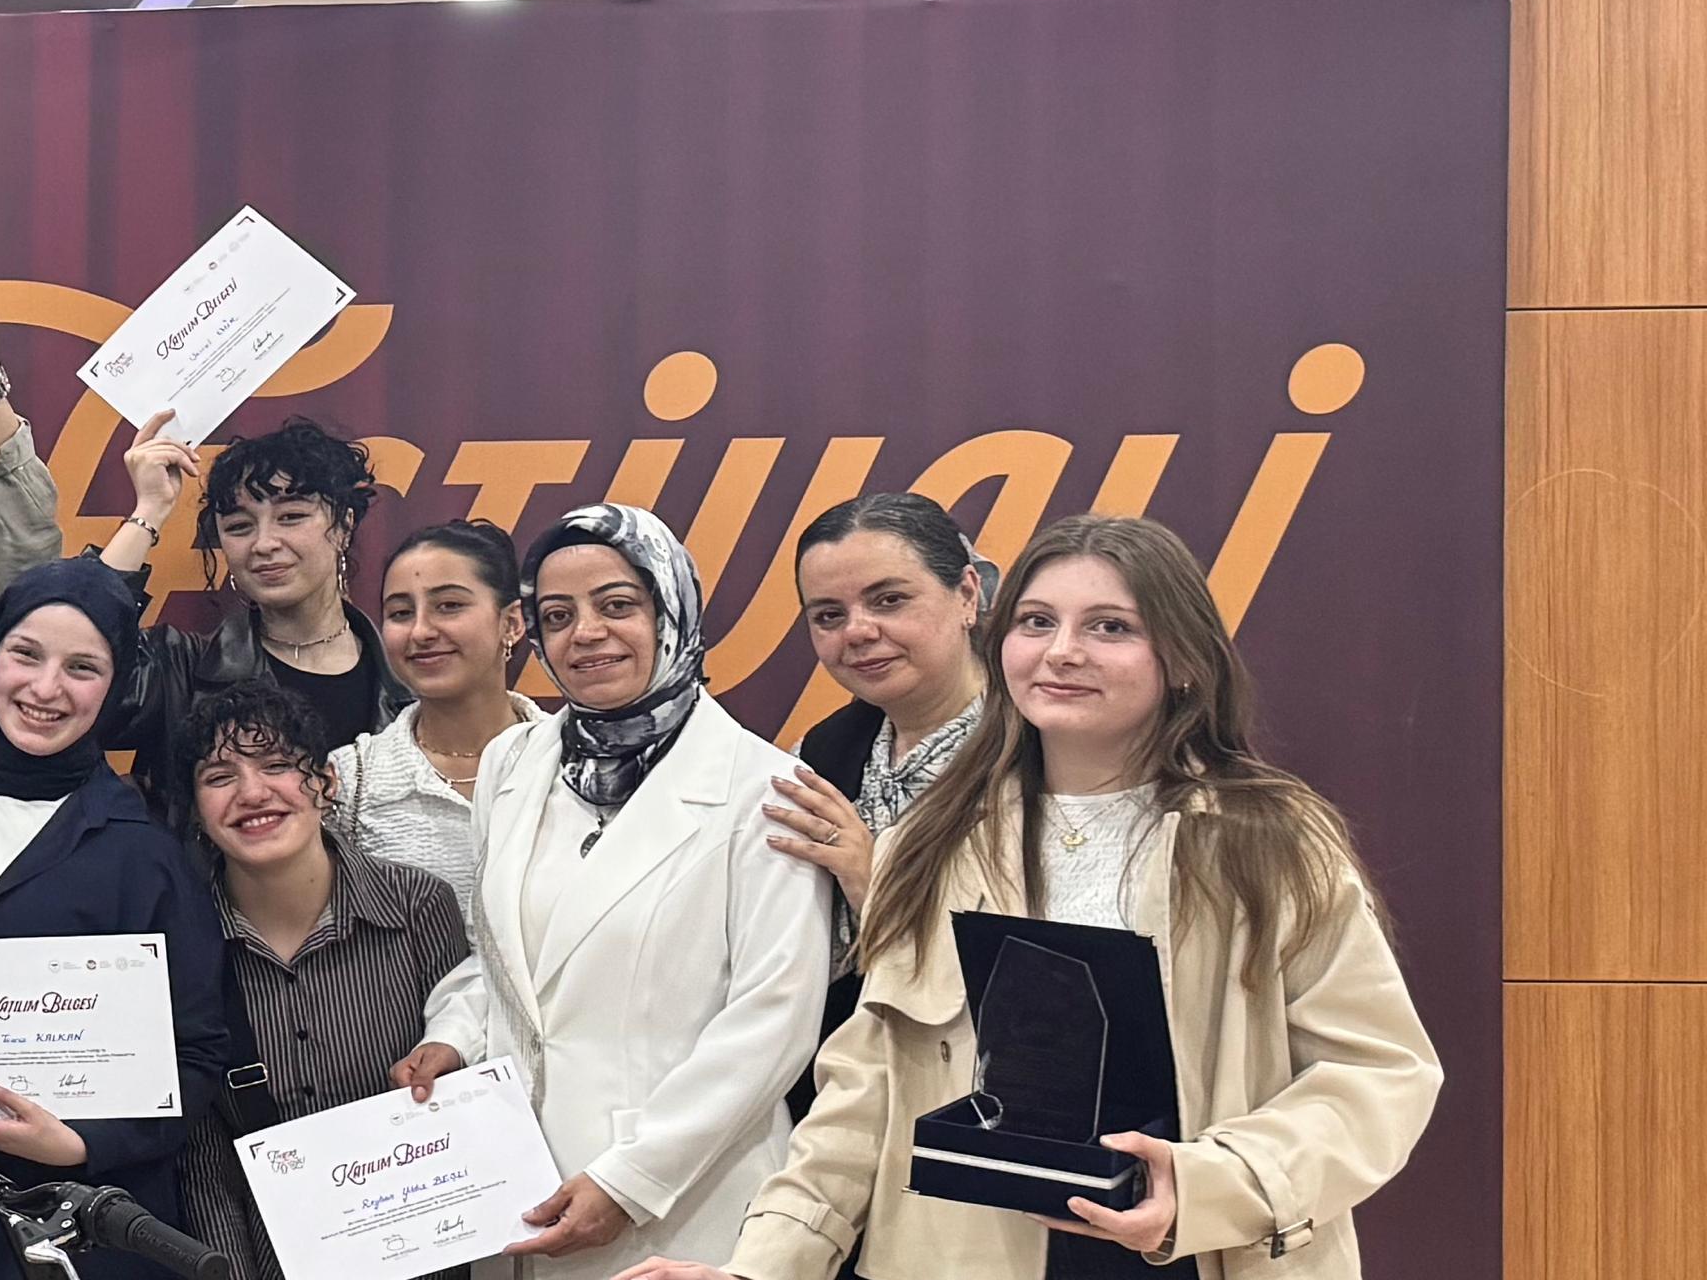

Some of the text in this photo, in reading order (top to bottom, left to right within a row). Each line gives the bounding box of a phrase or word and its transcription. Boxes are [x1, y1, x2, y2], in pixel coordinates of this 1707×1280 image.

[42, 991, 99, 1014] BELGESİ
[332, 1156, 392, 1187] KATILIM
[394, 1132, 450, 1167] BELGESİ
